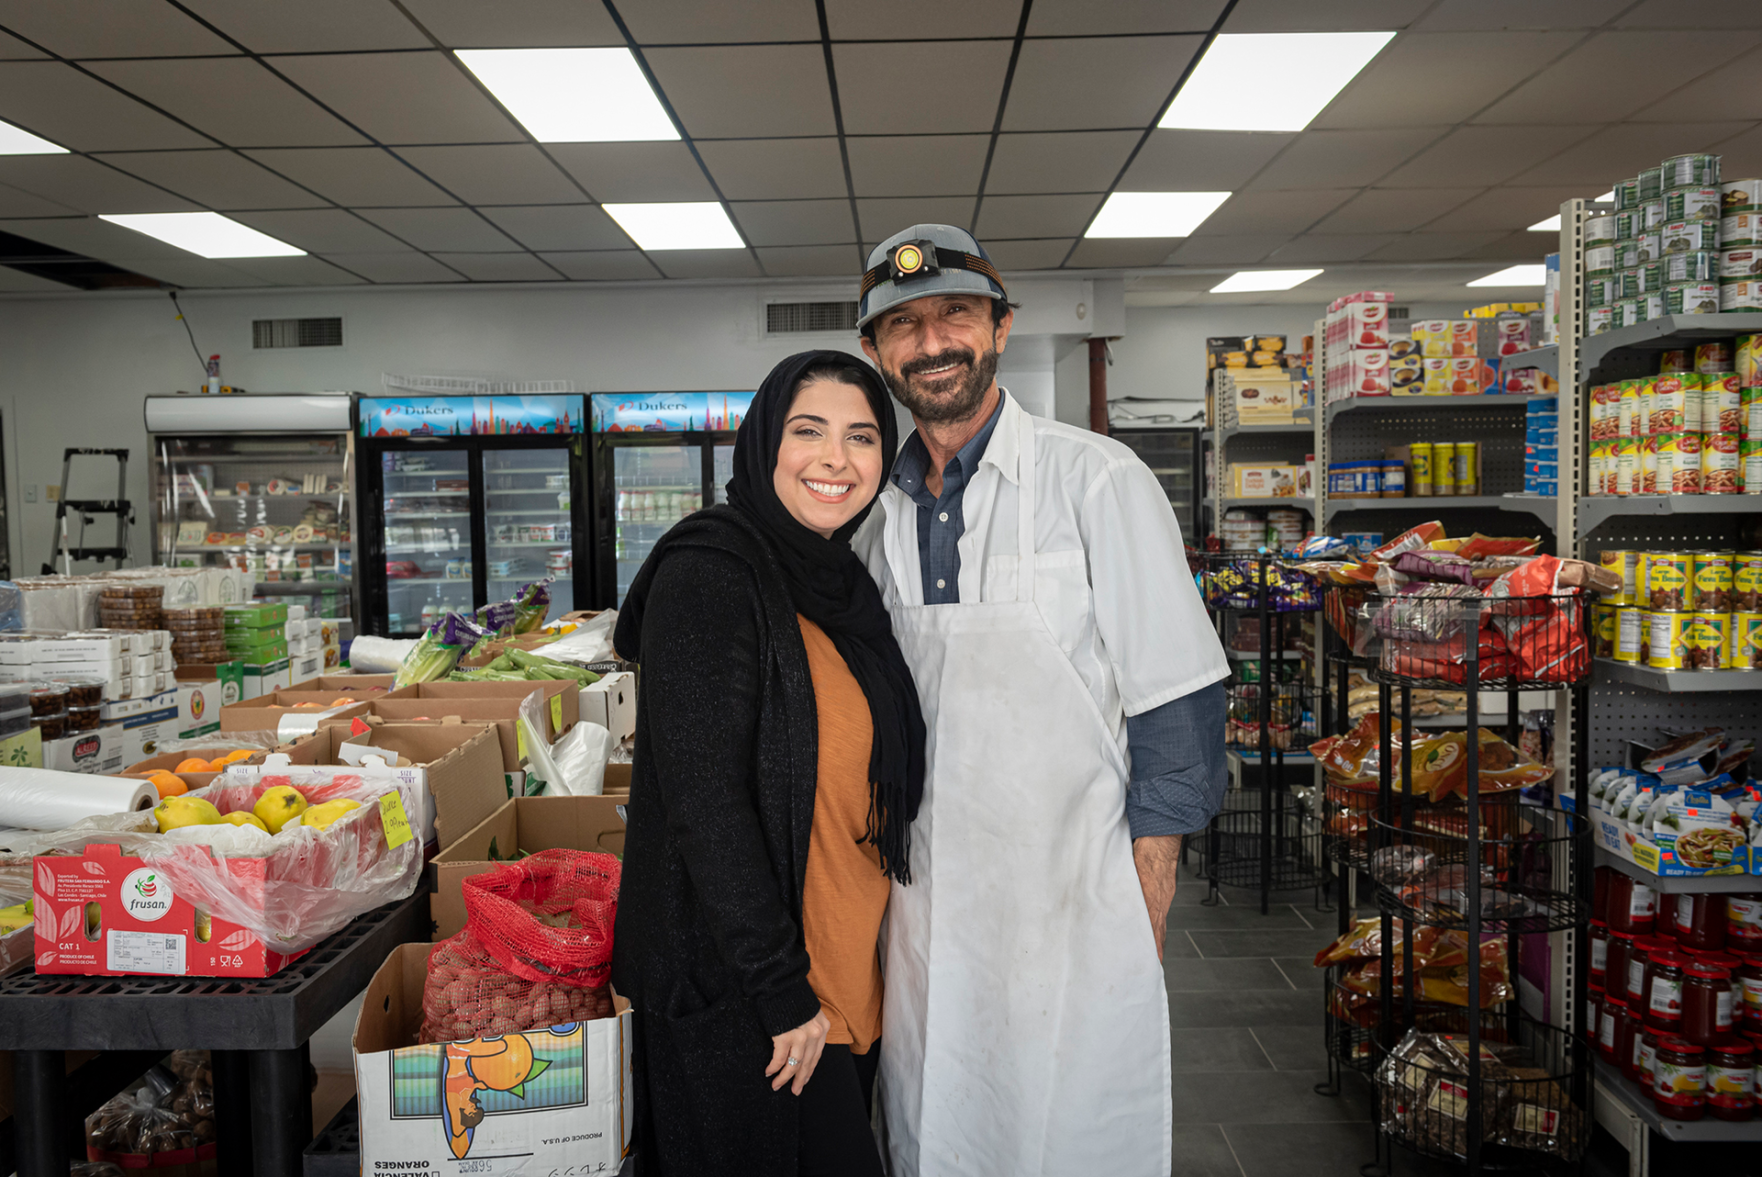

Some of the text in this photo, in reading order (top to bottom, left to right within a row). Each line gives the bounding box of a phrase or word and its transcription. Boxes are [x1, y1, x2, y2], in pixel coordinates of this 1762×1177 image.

[405, 405, 454, 415] Dukers
[639, 401, 688, 411] Dukers
[130, 899, 167, 911] frusan.
[59, 942, 73, 950] CAT
[571, 1132, 603, 1142] PRODUCE
[374, 1160, 430, 1169] ORANGES
